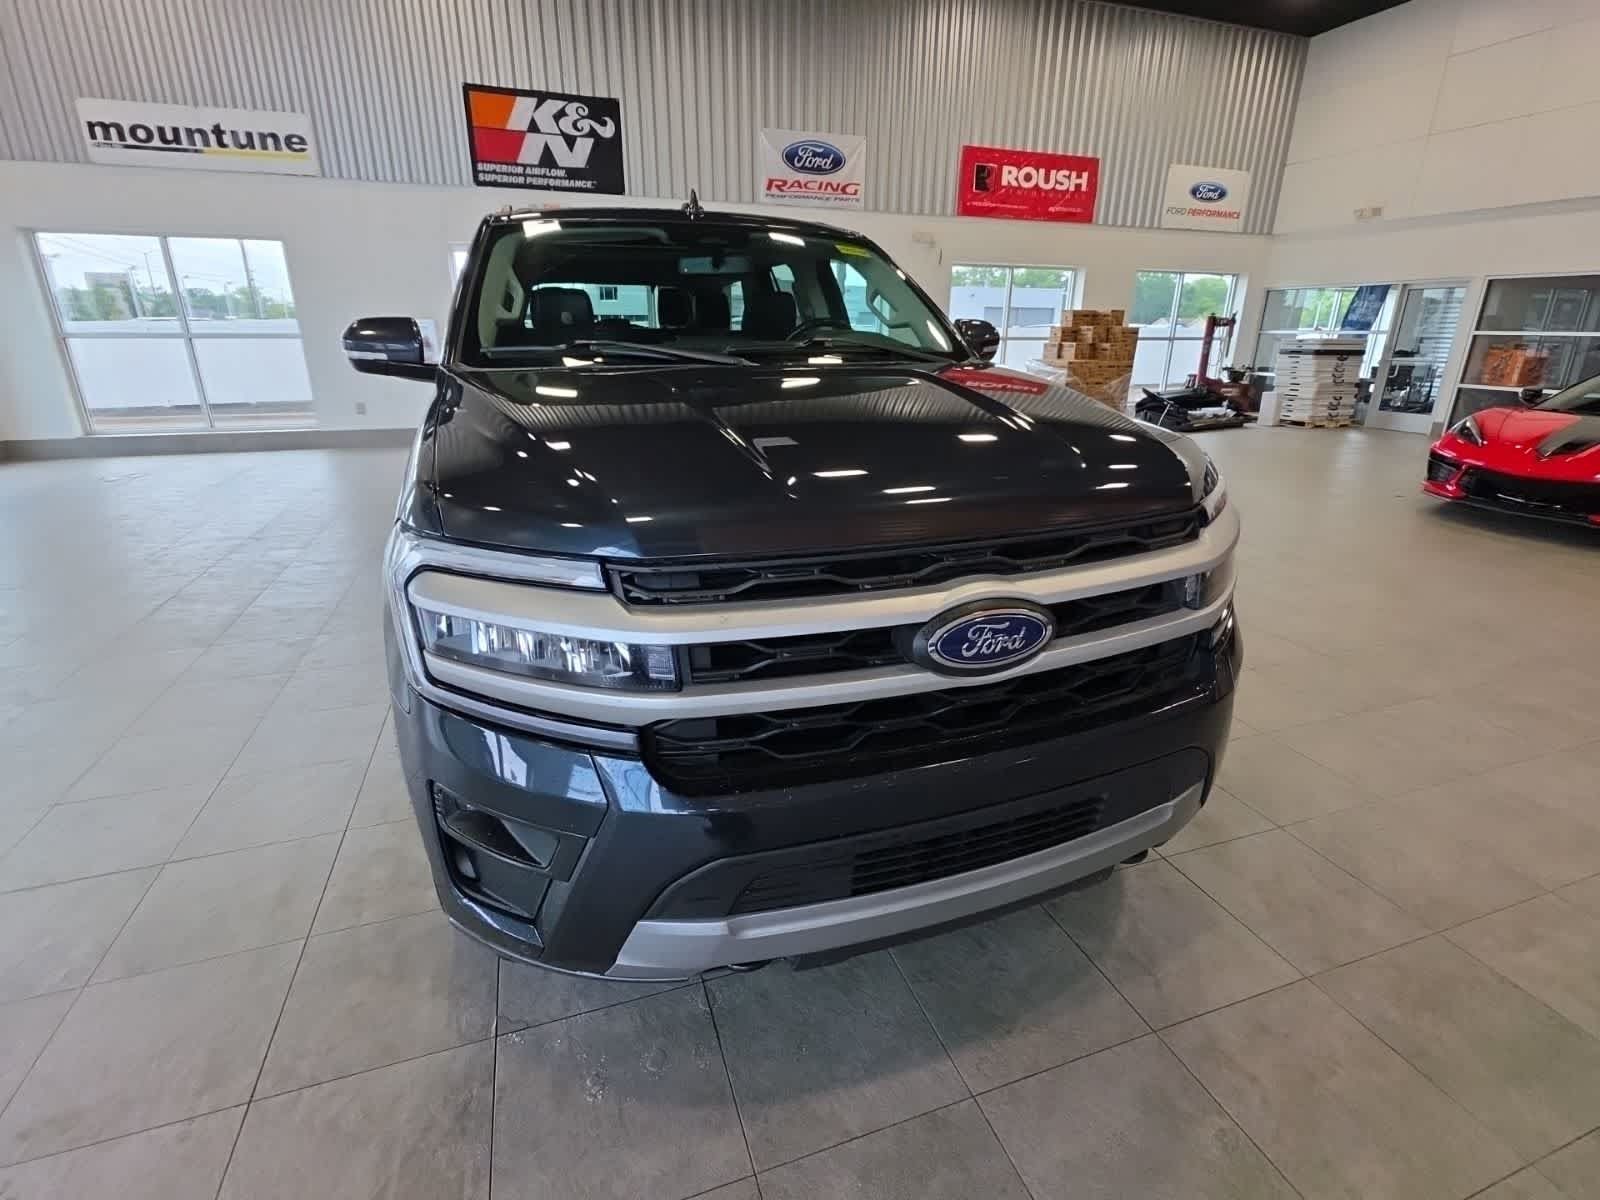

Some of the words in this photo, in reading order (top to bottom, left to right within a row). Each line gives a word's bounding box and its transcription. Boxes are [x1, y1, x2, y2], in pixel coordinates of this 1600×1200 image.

[86, 120, 308, 152] mountune
[795, 145, 834, 169] Ford
[477, 163, 523, 174] SUPERIOR
[478, 173, 524, 184] SUPERIOR
[766, 178, 860, 195] RACING
[1001, 165, 1088, 192] ROUSH
[1196, 184, 1220, 199] Ford
[1167, 207, 1186, 215] FORD
[1187, 207, 1240, 219] PERFORMANCE
[961, 621, 1026, 657] Ford
